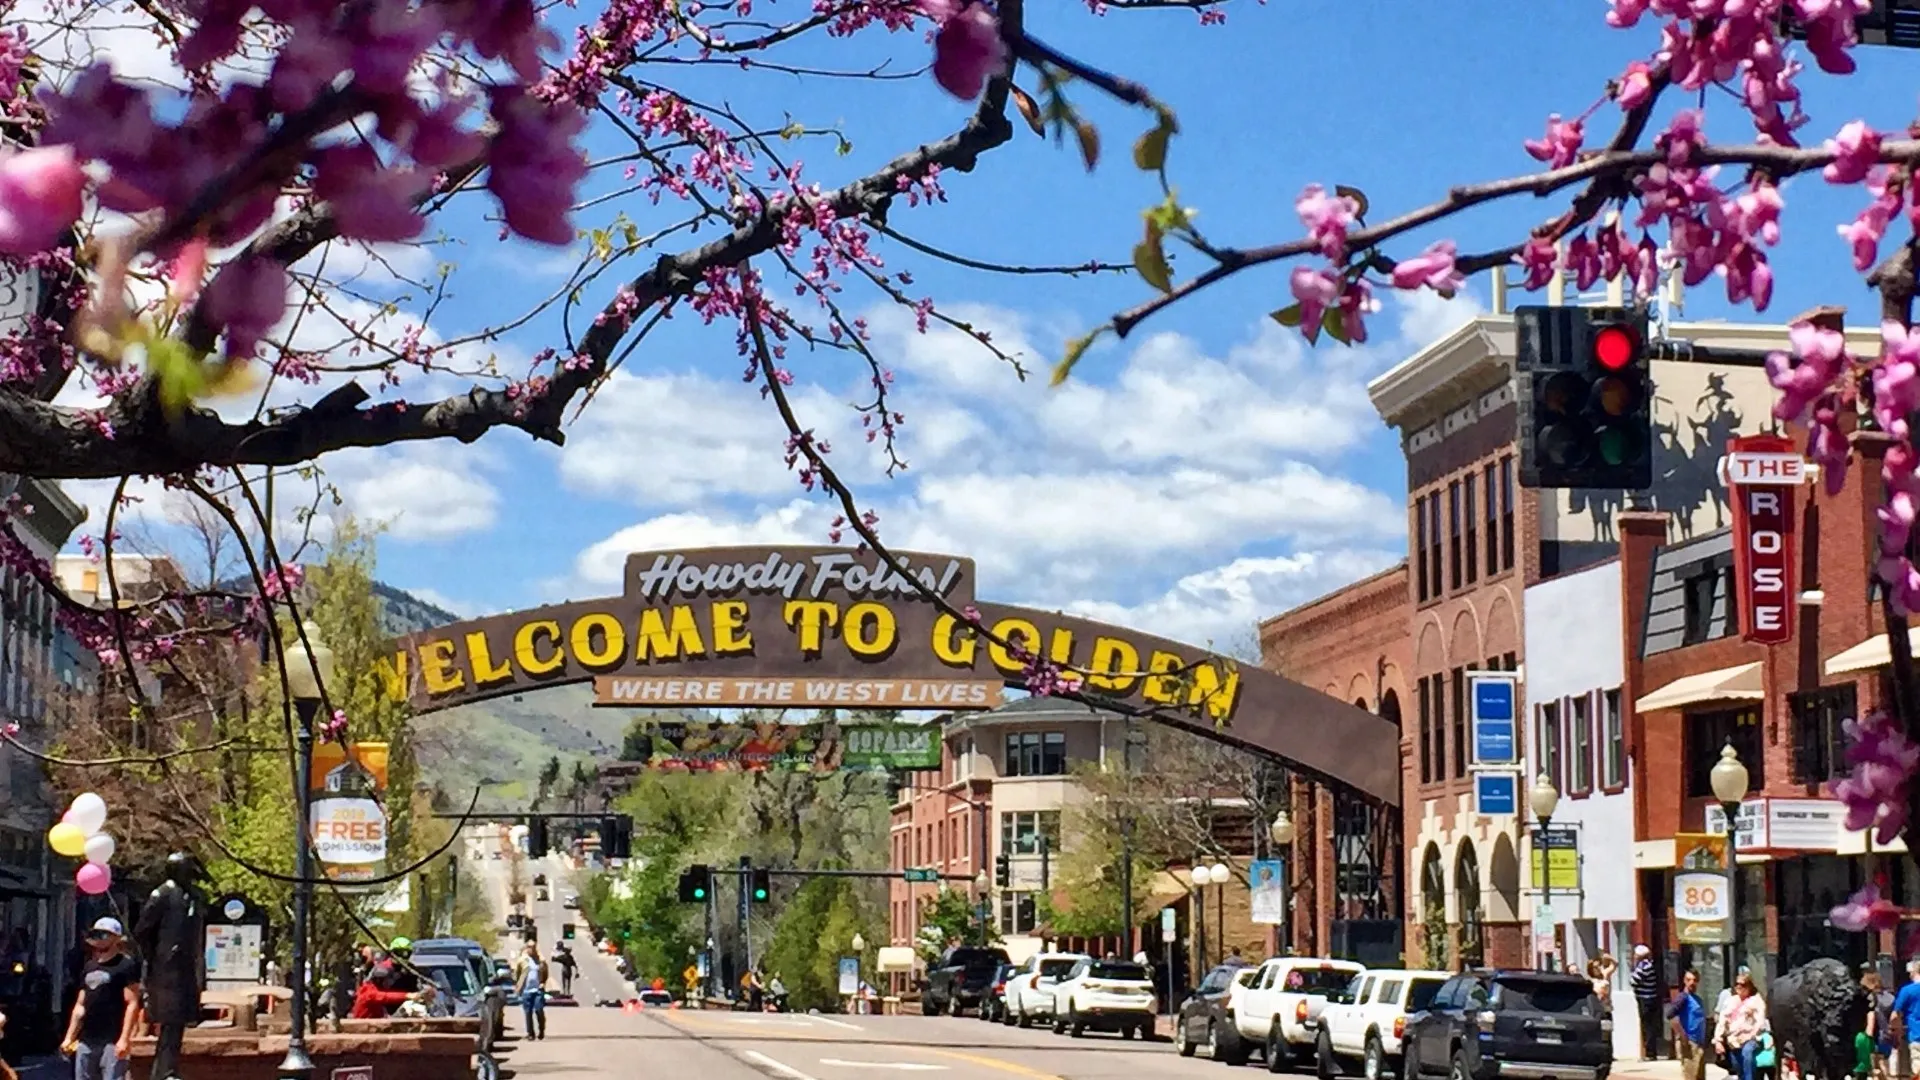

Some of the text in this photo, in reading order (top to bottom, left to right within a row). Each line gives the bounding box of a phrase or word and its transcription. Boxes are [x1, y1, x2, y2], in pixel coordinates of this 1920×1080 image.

[1737, 459, 1799, 477] THE
[1751, 492, 1783, 630] ROSE
[639, 552, 961, 599] Howdy Folks!
[783, 600, 896, 656] TO
[931, 612, 1240, 719] GOLDEN
[611, 681, 987, 703] WHERE THE WEST LIVES
[315, 821, 382, 841] FREE
[1685, 887, 1717, 906] 80
[1685, 906, 1719, 916] YEARS
